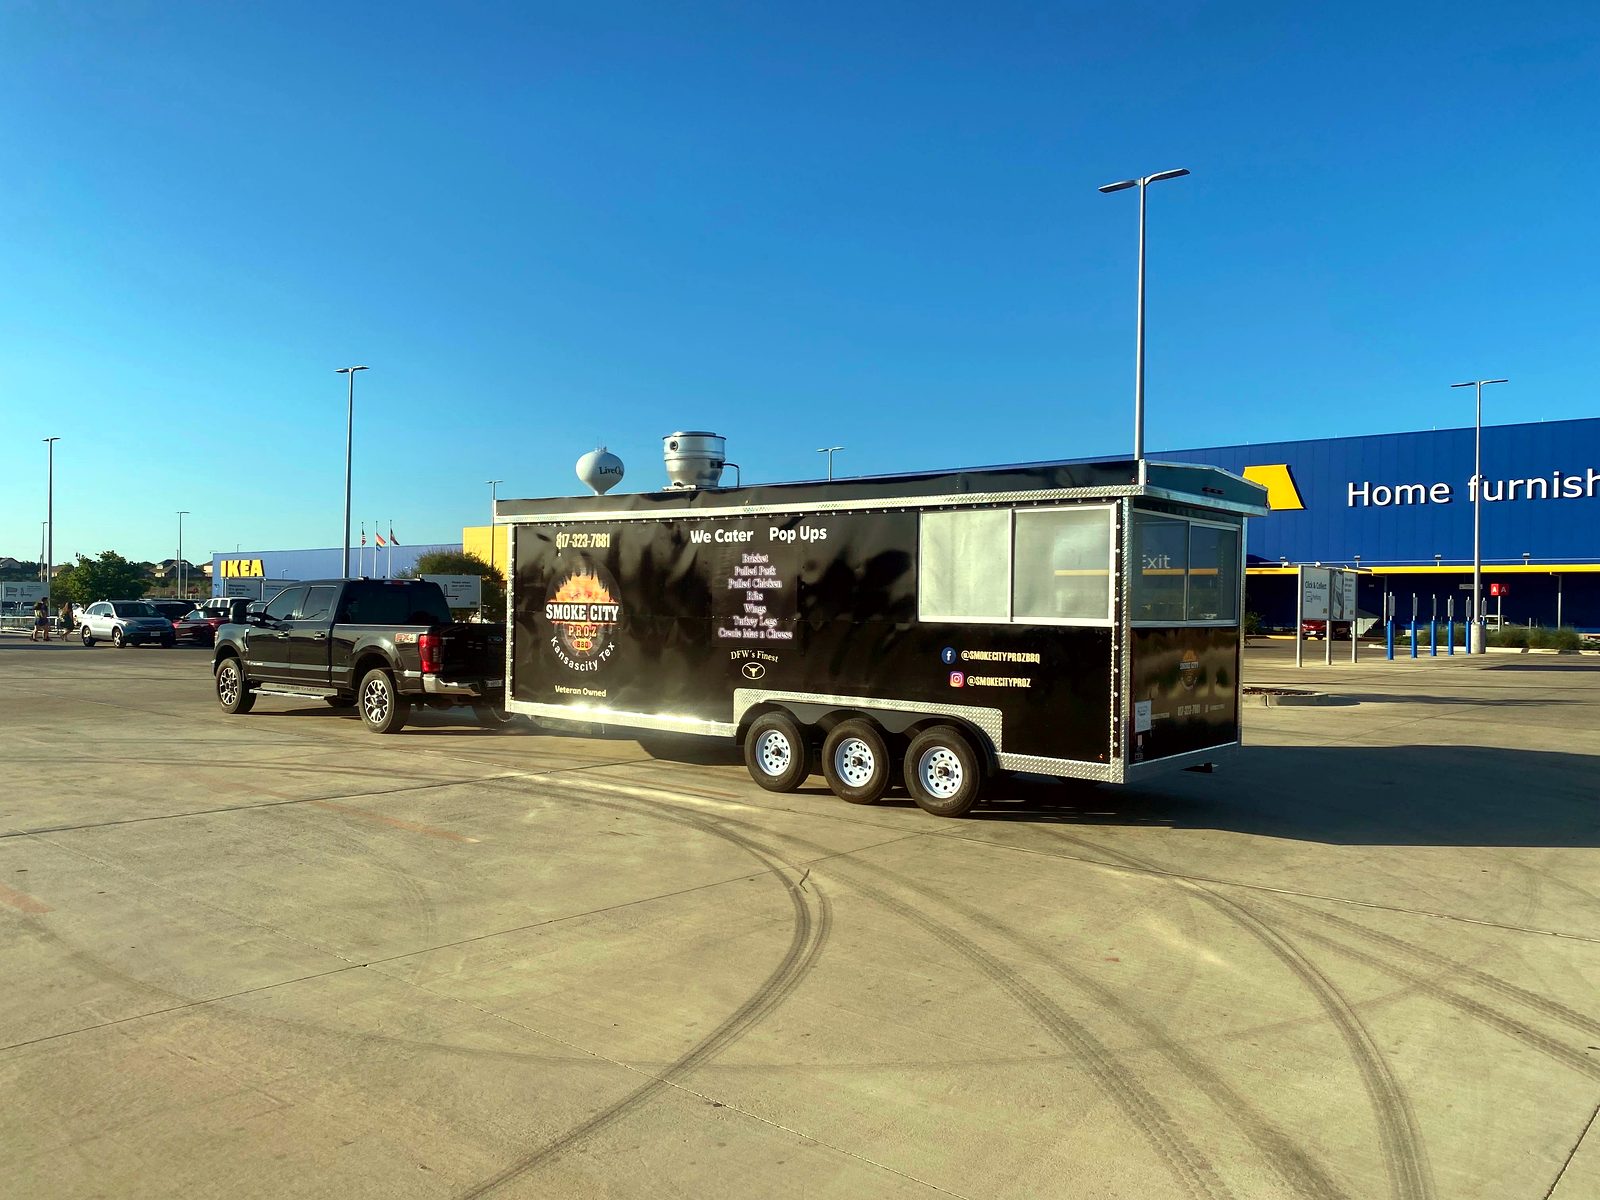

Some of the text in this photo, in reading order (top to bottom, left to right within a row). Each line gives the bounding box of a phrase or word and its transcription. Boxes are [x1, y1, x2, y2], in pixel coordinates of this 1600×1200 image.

[1347, 481, 1451, 507] Home
[690, 529, 754, 543] We Cater
[769, 525, 827, 543] Pop Ups
[220, 559, 264, 577] IKEA
[734, 565, 777, 576] Pulled Pork
[728, 578, 782, 589] Pulled Chicken
[746, 591, 763, 601] Ribs
[545, 604, 619, 622] SMOKE CITY
[743, 603, 767, 615] Wings
[568, 625, 597, 638] PROZ
[766, 629, 793, 640] Cheese
[598, 641, 615, 661] Tex
[757, 651, 779, 663] Finest
[555, 685, 607, 698] Veteran Owned
